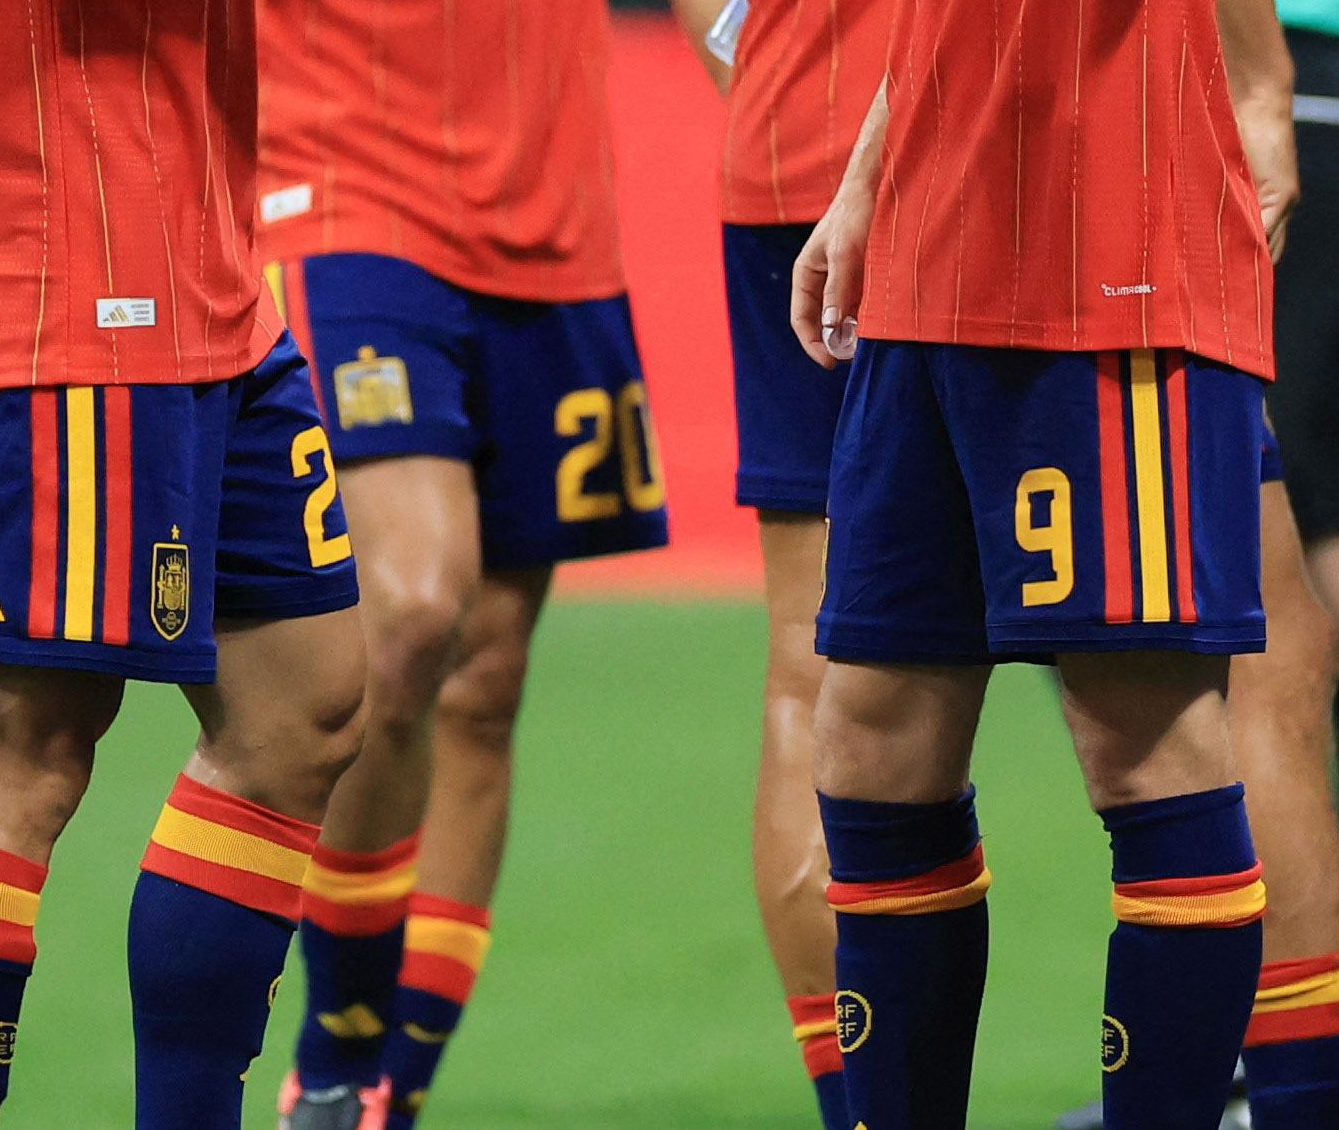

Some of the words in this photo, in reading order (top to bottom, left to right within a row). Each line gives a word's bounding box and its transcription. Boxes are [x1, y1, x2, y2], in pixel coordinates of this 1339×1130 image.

[291, 425, 352, 568] 2
[554, 381, 665, 523] 20
[1014, 467, 1074, 607] 9
